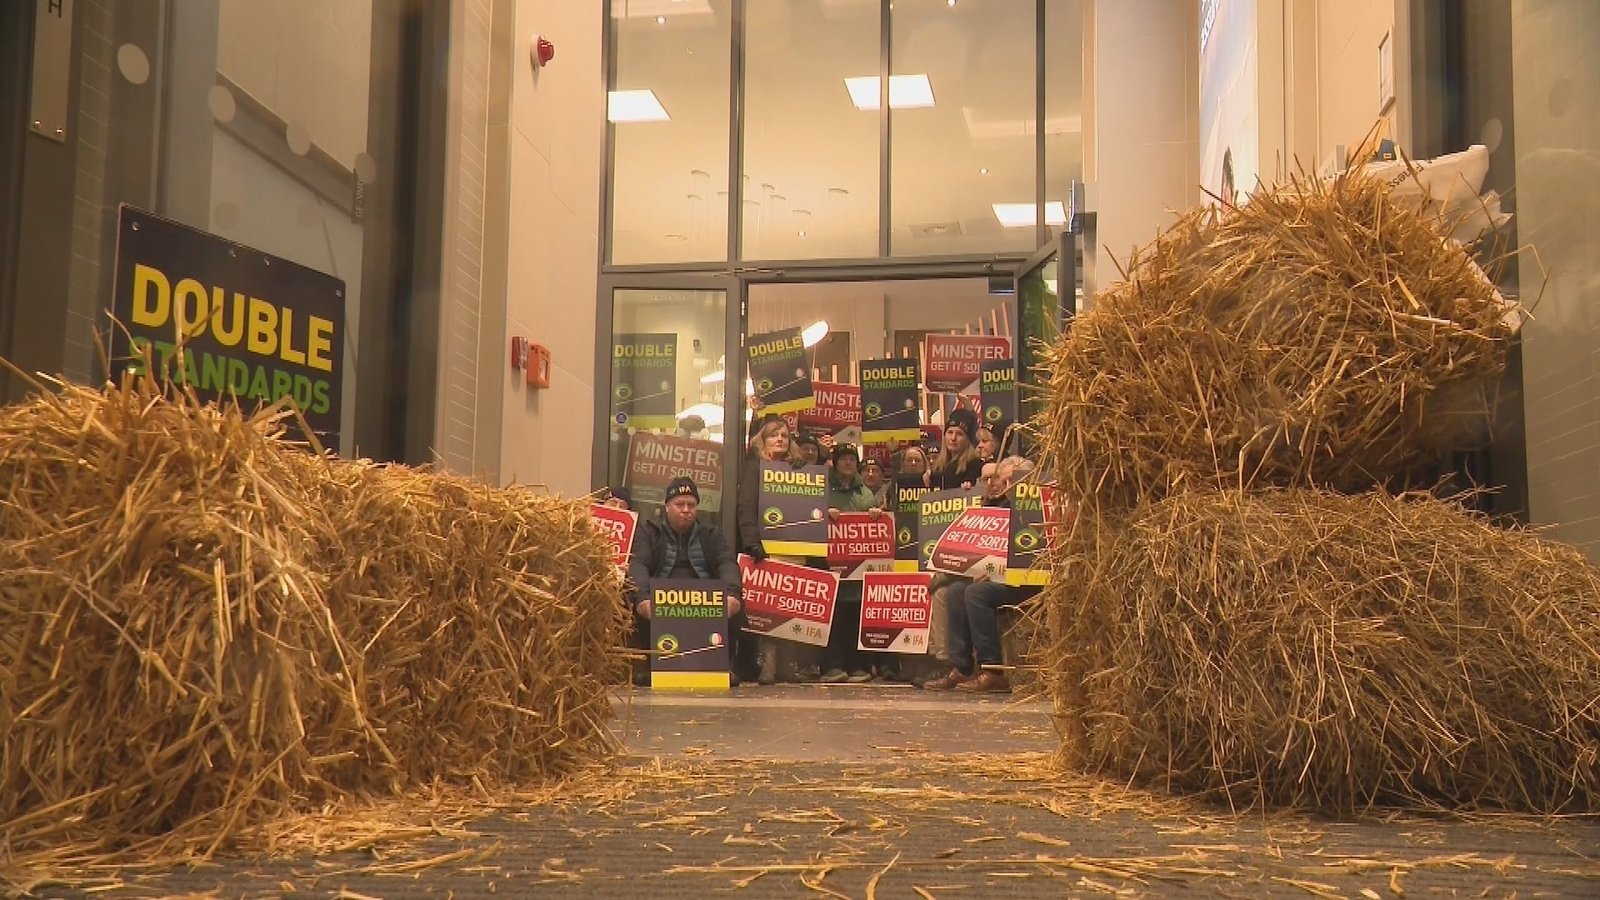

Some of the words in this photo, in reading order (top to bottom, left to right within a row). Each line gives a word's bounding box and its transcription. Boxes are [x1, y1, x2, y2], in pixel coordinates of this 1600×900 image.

[132, 263, 334, 372] DOUBLE
[614, 344, 673, 358] DOUBLE
[749, 336, 802, 358] DOUBLE
[614, 358, 672, 368] STANDARDS
[751, 350, 802, 365] STANDARDS
[862, 366, 914, 381] DOUBLE
[930, 361, 948, 371] GET
[950, 362, 960, 371] IT
[128, 336, 331, 415] STANDARDS
[862, 380, 915, 390] STANDARDS
[824, 408, 833, 418] IT
[834, 410, 861, 422] SORT
[633, 462, 655, 475] GET
[657, 464, 668, 475] IT
[669, 467, 716, 484] SORTED
[764, 469, 826, 486] DOUBLE
[679, 485, 692, 493] IFA
[764, 484, 825, 496] STANDARDS
[922, 496, 982, 516] DOUBLE
[828, 522, 891, 539] INISTER,
[957, 514, 1010, 532] MINIST
[947, 532, 968, 542] GET
[967, 533, 978, 544] IT
[837, 543, 846, 554] IT
[849, 542, 890, 554] SORTED
[654, 590, 724, 606] DOUBLE
[764, 592, 776, 605] IT
[778, 596, 826, 616] SORTED
[654, 606, 724, 618] STANDARDS
[866, 606, 882, 620] GET
[882, 607, 892, 620] IT
[892, 608, 926, 622] SORTED
[806, 626, 822, 639] IFA
[912, 635, 924, 646] IFA
